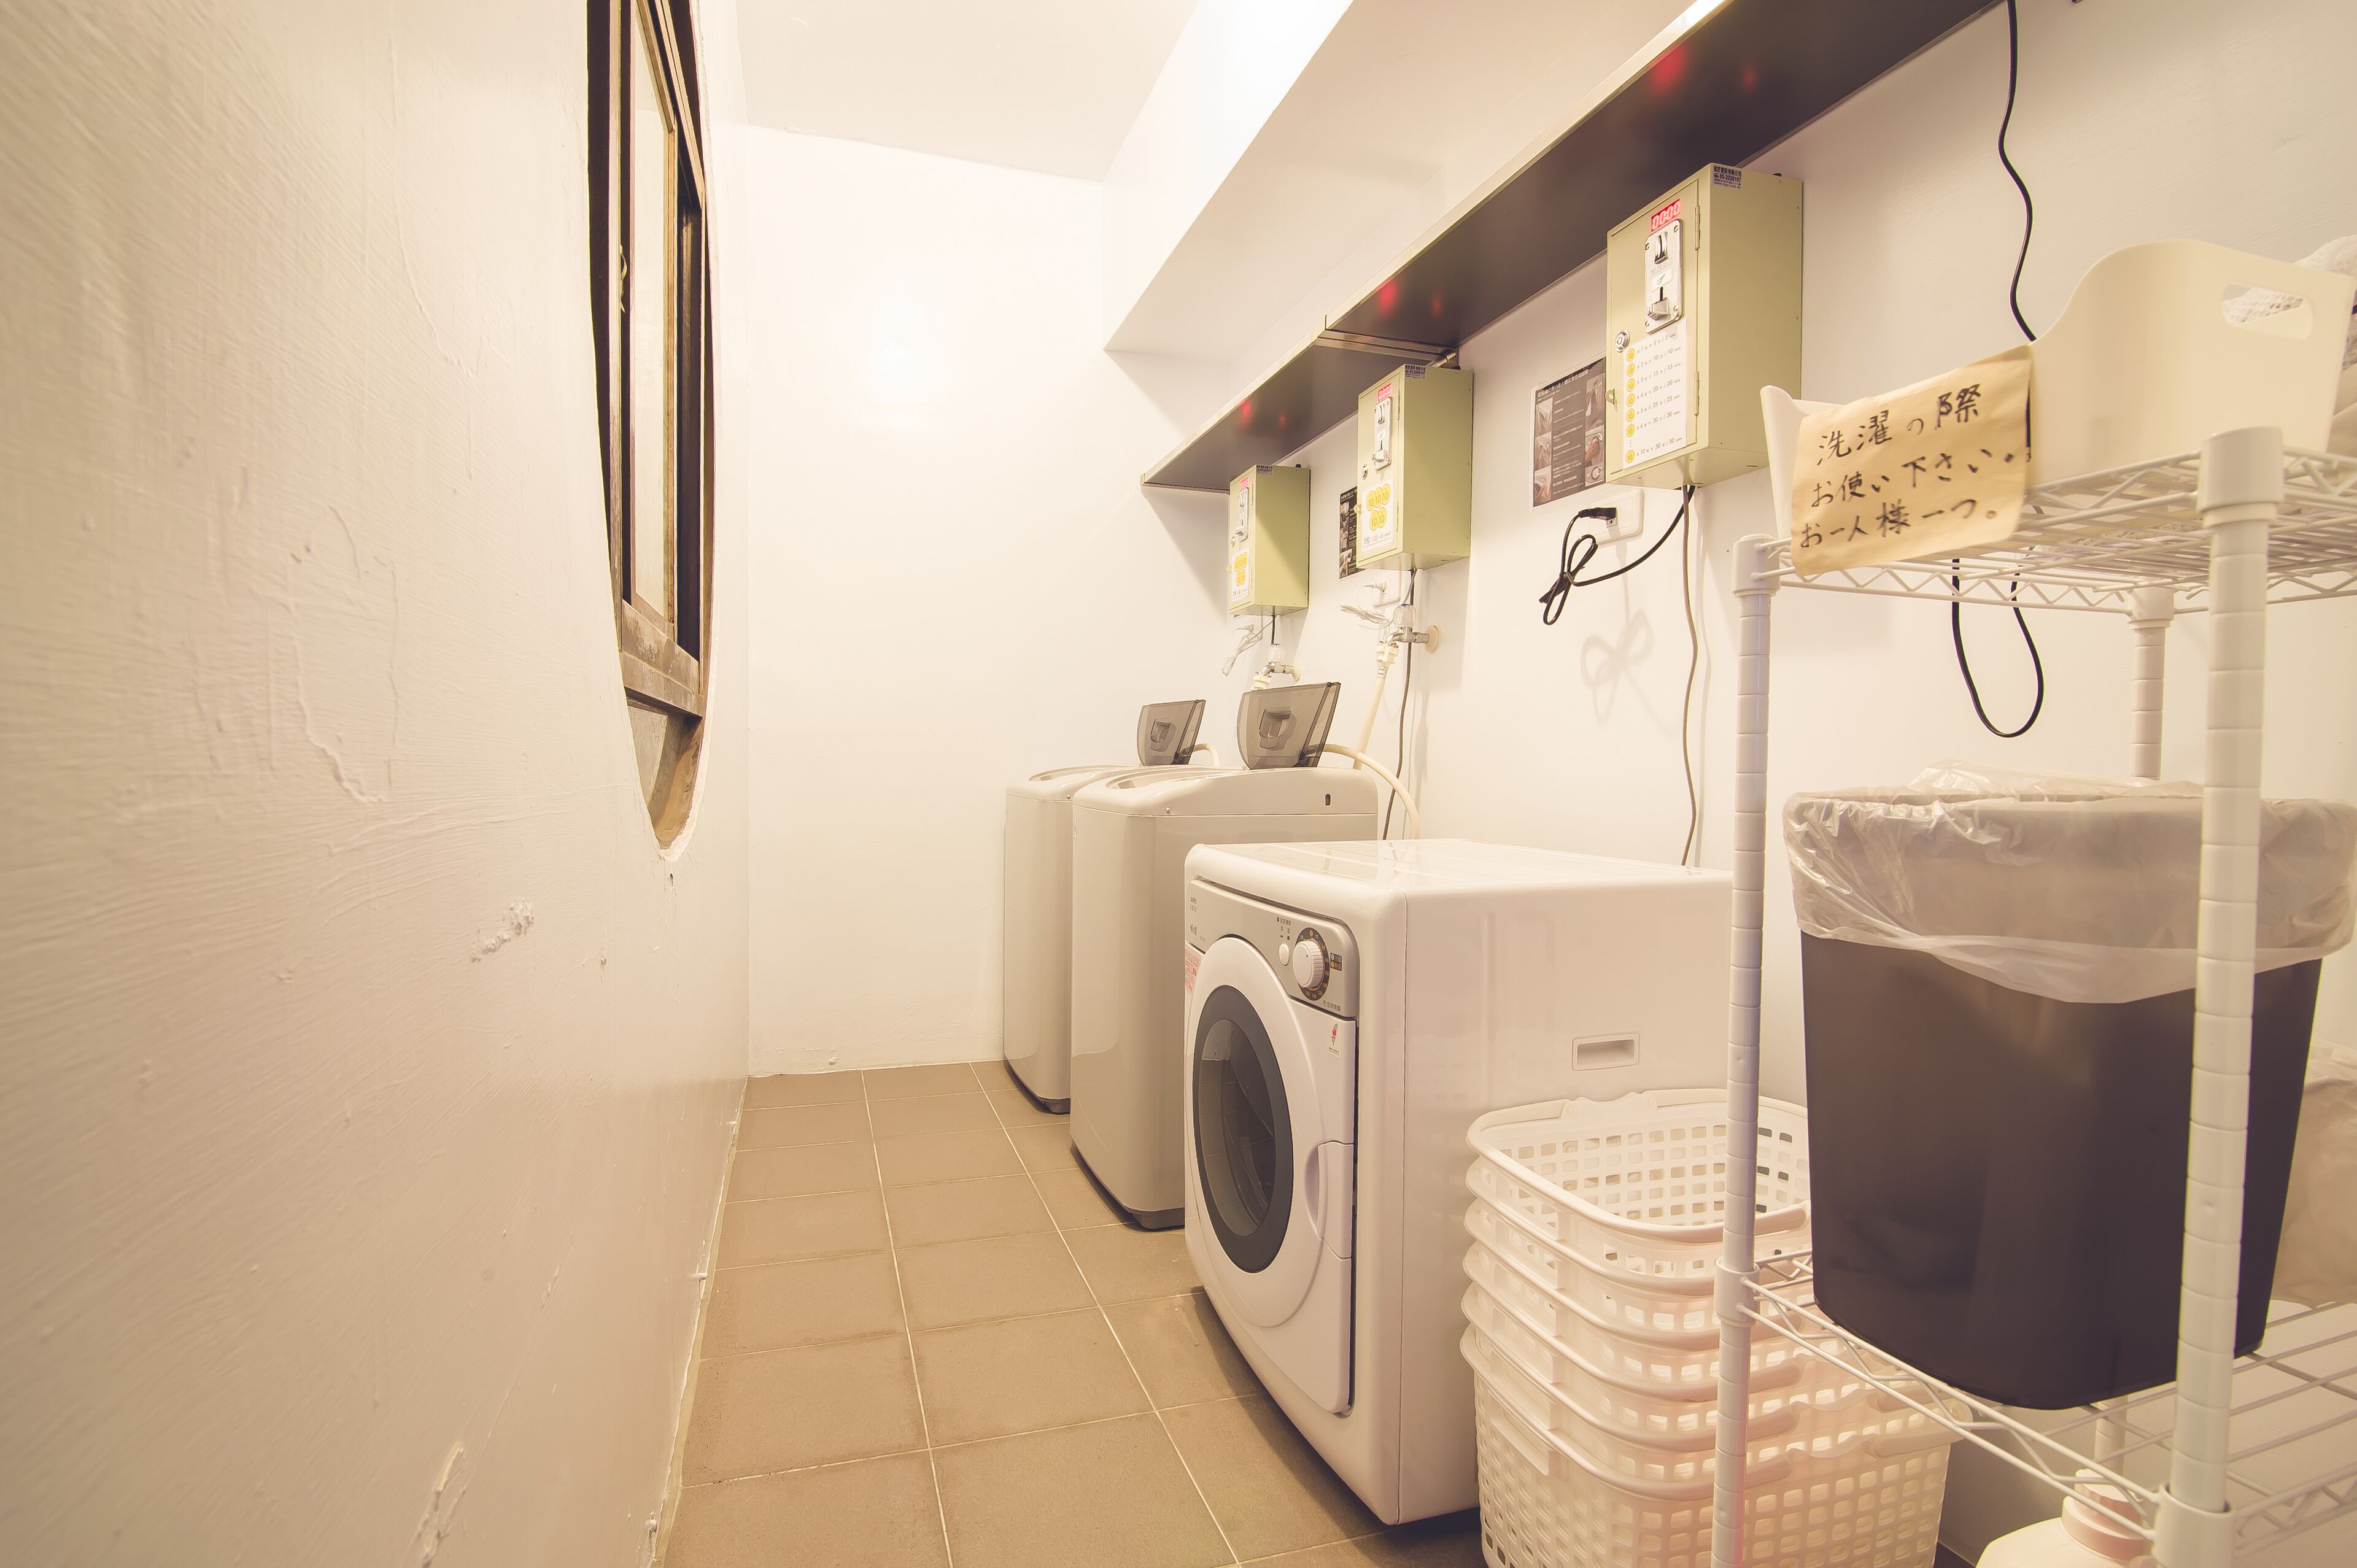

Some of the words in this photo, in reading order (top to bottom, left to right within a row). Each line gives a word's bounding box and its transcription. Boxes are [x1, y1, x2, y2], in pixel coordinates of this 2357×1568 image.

[1817, 384, 1981, 465] 洗濯の際
[1368, 498, 1374, 508] 10
[1376, 495, 1381, 504] 10
[1383, 492, 1388, 501] 10
[1372, 517, 1377, 527] 10
[1379, 514, 1384, 524] 10
